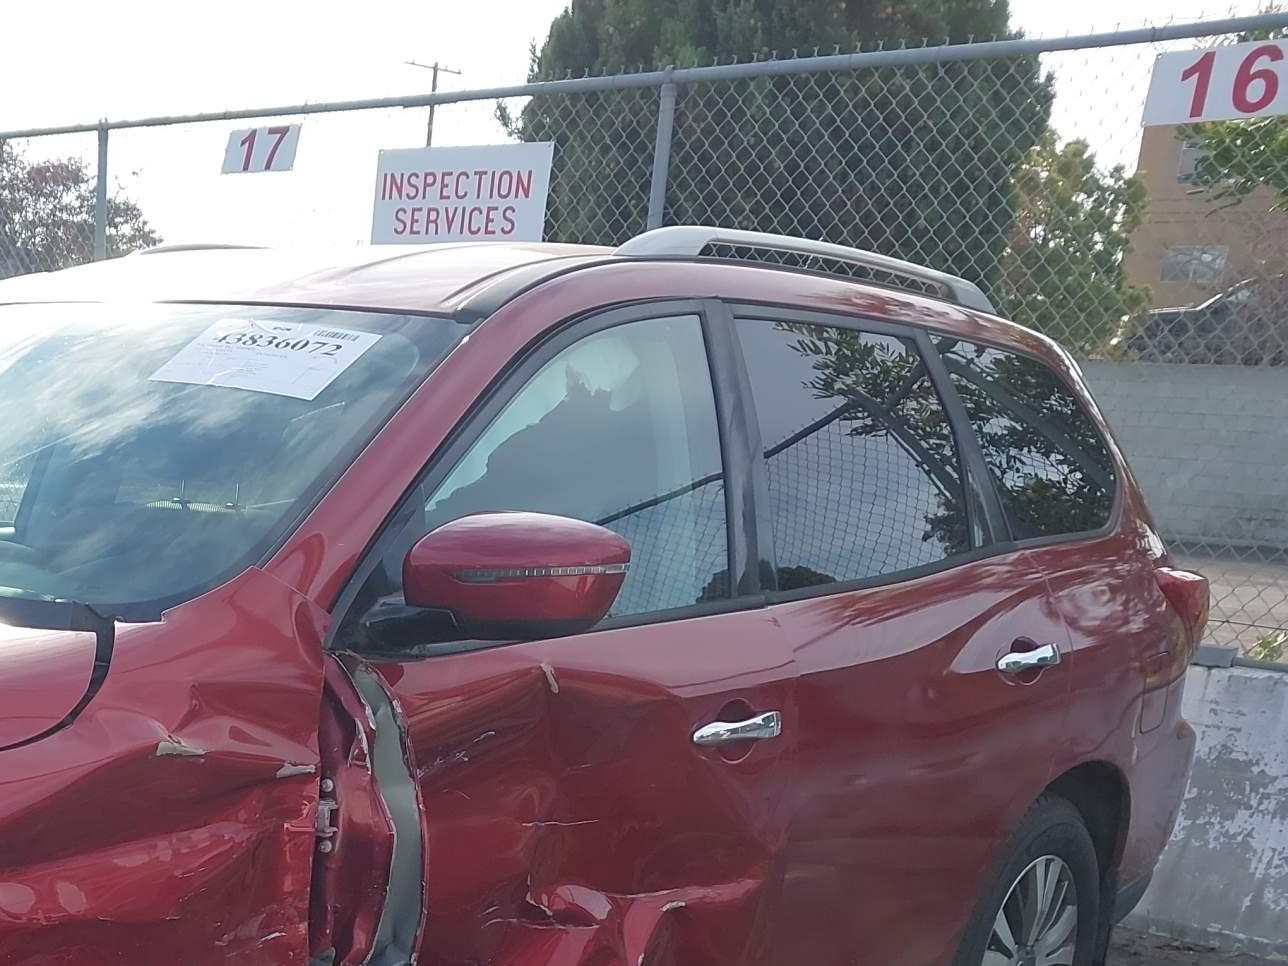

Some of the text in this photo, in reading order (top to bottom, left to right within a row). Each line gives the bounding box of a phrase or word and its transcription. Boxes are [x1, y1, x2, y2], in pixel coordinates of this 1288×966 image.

[1180, 44, 1285, 118] 16
[239, 125, 290, 172] 17
[380, 169, 533, 201] INSPECTION
[392, 205, 517, 236] SERVICES
